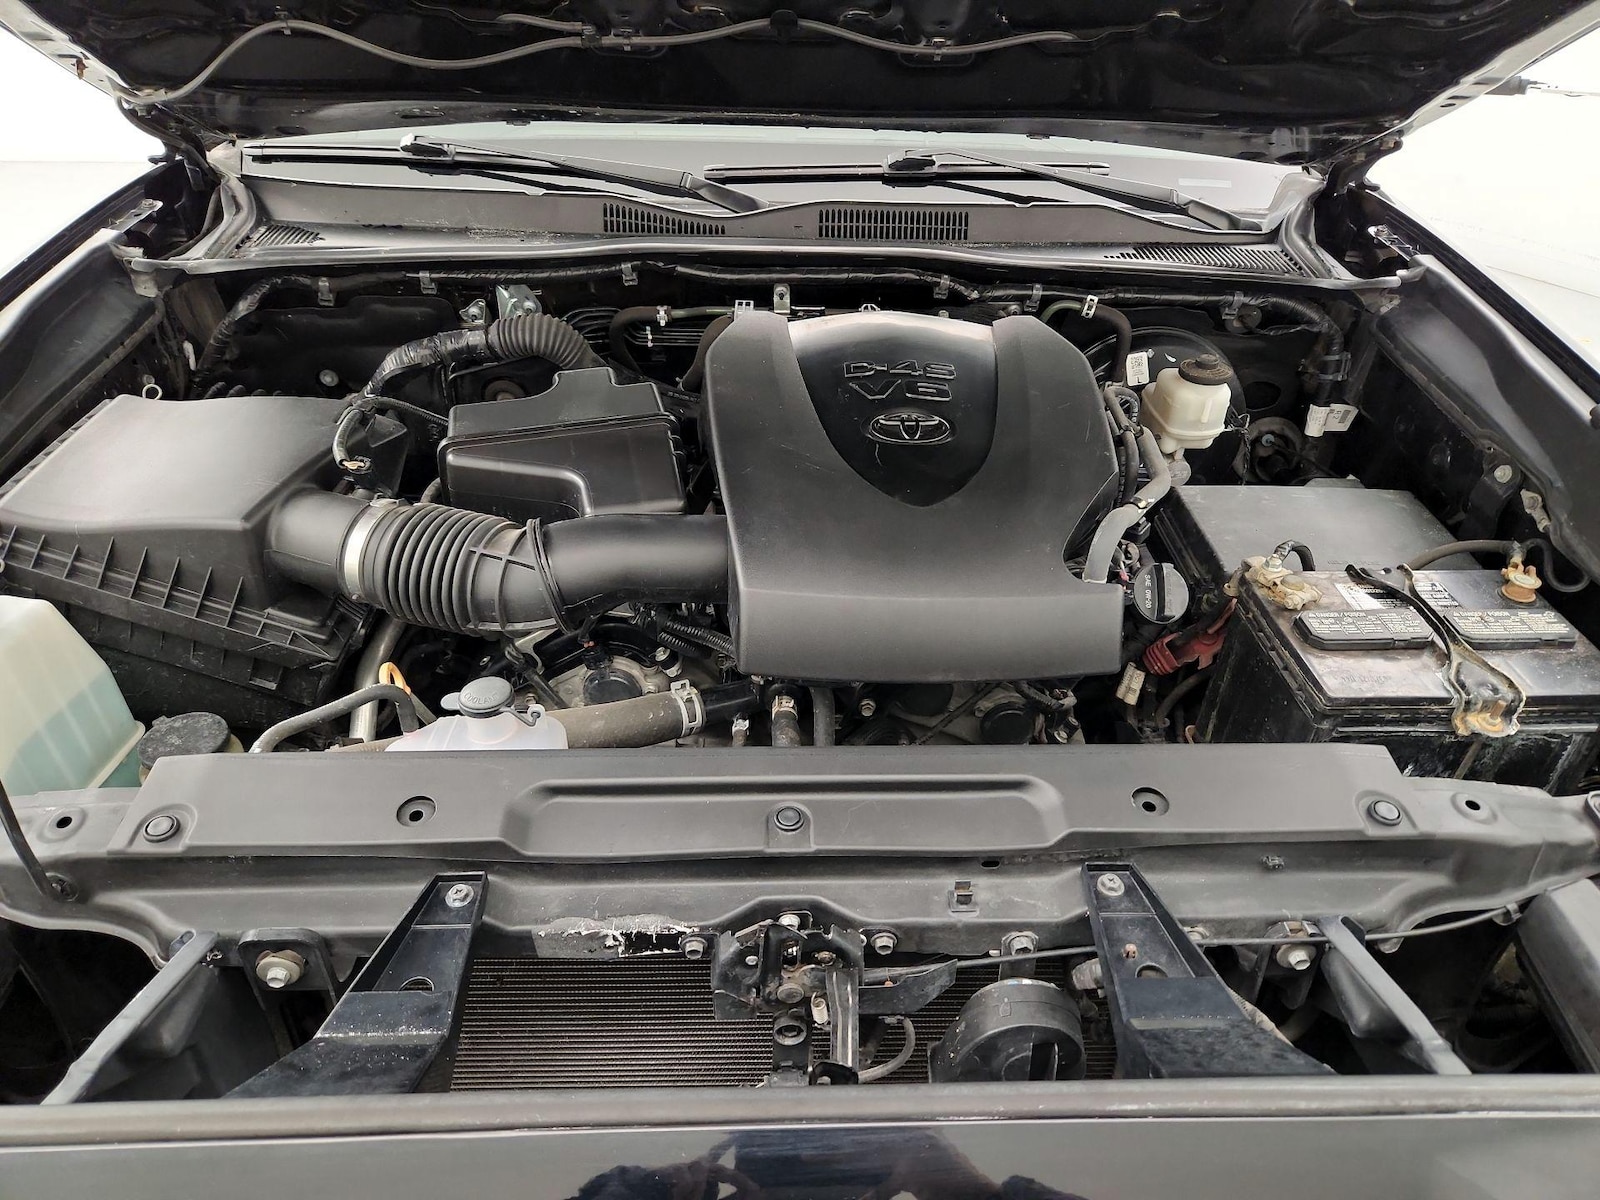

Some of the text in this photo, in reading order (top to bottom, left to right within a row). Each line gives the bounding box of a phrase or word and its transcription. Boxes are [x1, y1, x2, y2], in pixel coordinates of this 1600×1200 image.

[843, 359, 957, 380] D-4S
[849, 379, 952, 401] V6
[1144, 574, 1152, 587] SAE
[464, 691, 499, 704] COOLANT
